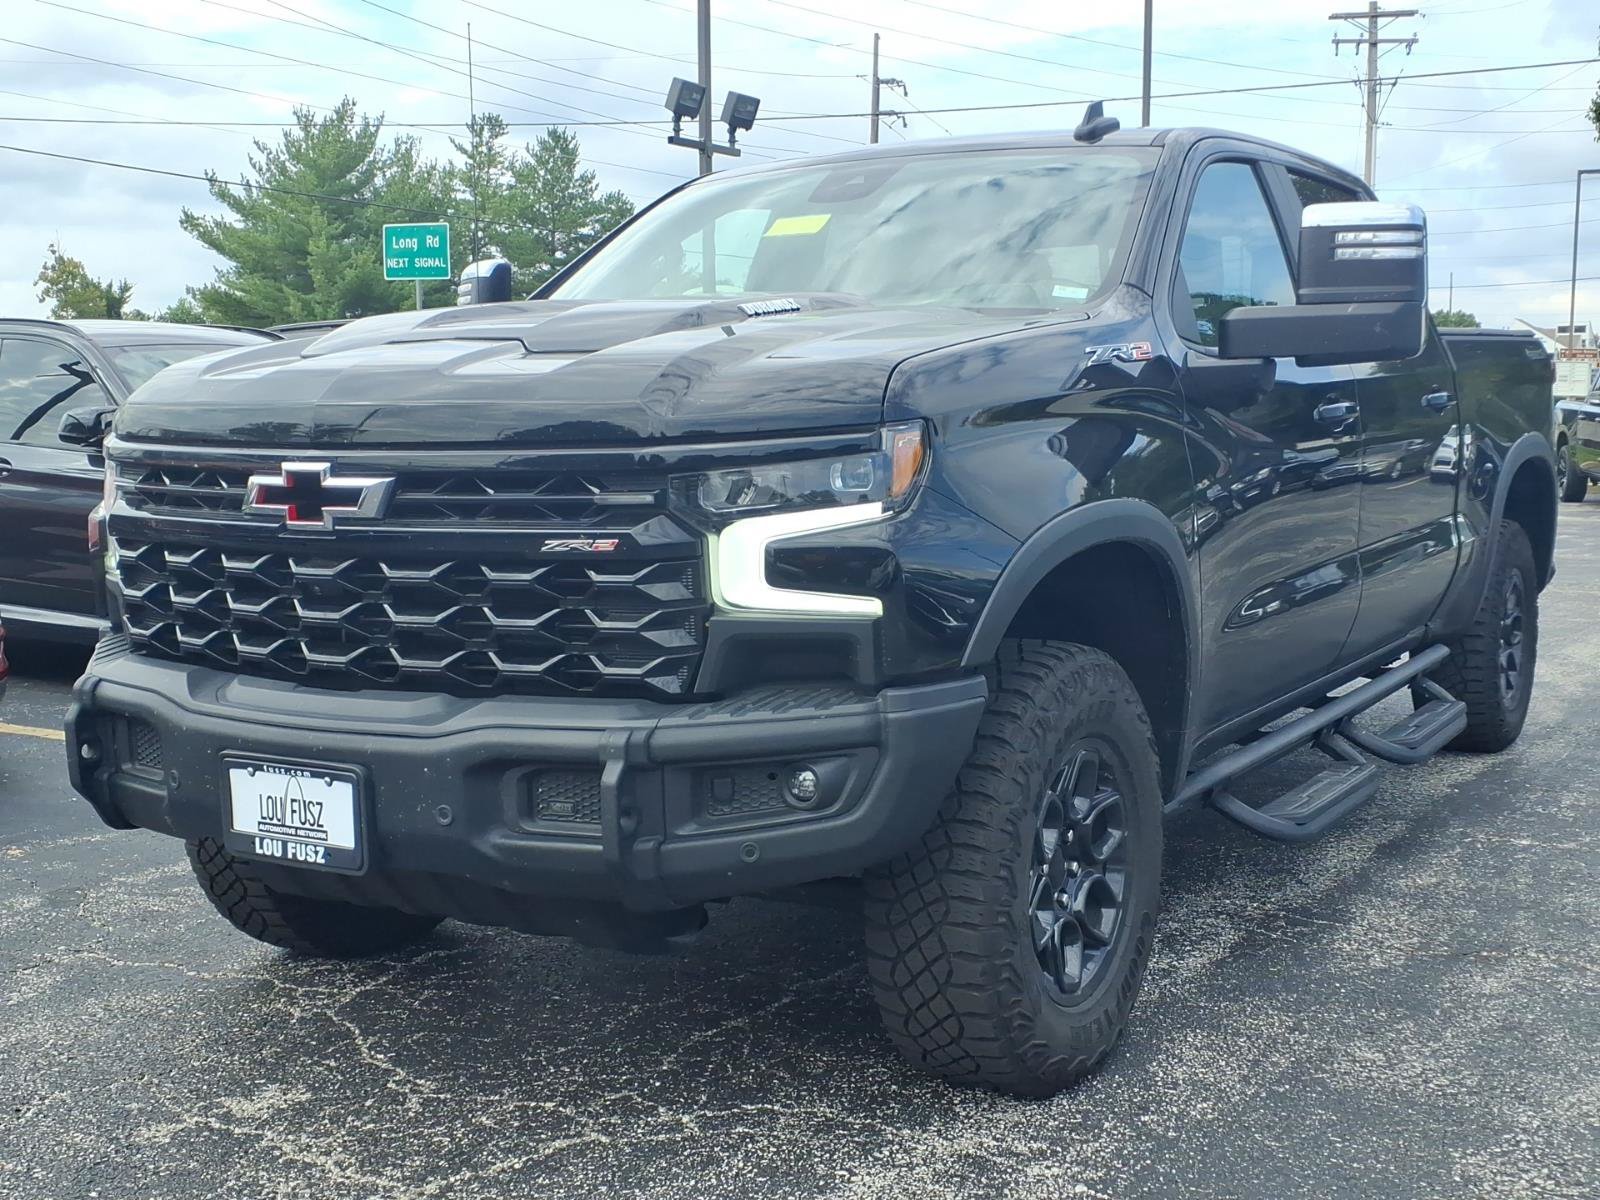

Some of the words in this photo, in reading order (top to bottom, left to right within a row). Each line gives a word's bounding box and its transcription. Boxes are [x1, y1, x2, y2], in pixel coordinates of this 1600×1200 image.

[392, 236, 418, 252] Long
[426, 235, 440, 248] Rd
[387, 257, 410, 269] NEXT
[414, 257, 446, 268] SIGNAL
[1085, 341, 1153, 366] ZR2
[540, 539, 620, 552] ZR2
[259, 794, 282, 822] LOU
[290, 798, 324, 828] FUSZ
[259, 824, 296, 835] AUTOMOTIVE
[297, 829, 327, 840] NETWORK
[255, 837, 282, 857] LOU
[287, 842, 325, 864] FUSZ
